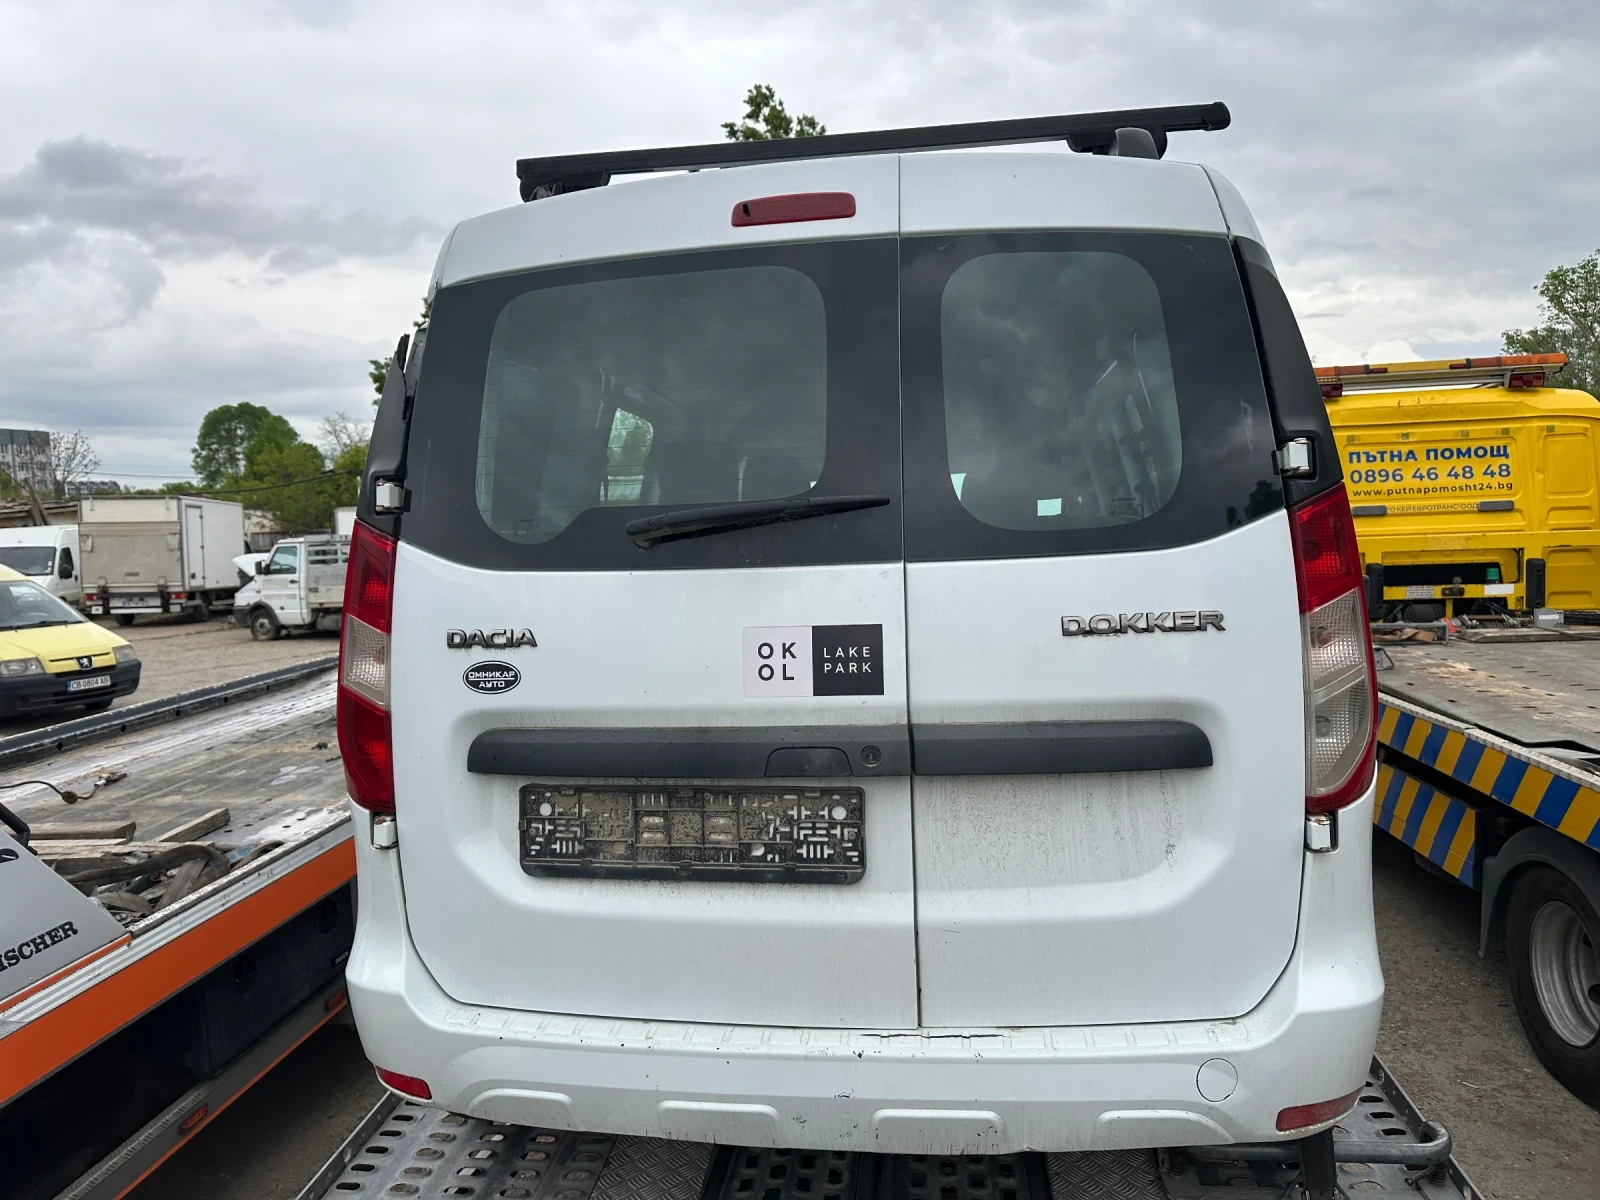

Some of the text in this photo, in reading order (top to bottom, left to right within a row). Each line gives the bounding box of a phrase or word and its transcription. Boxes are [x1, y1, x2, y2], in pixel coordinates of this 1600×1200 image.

[1348, 445, 1510, 464] ПЪТНА ПОМОЩ
[1349, 463, 1511, 484] 0896 46 48 48
[1352, 482, 1513, 497] www.putnapomosht24.bg
[1061, 610, 1226, 637] DOKKER
[447, 628, 537, 649] DACIA
[823, 646, 871, 658] LAKE
[468, 671, 515, 679] ОМНИКАР
[824, 662, 872, 674] PARK
[479, 680, 505, 688] АУТО
